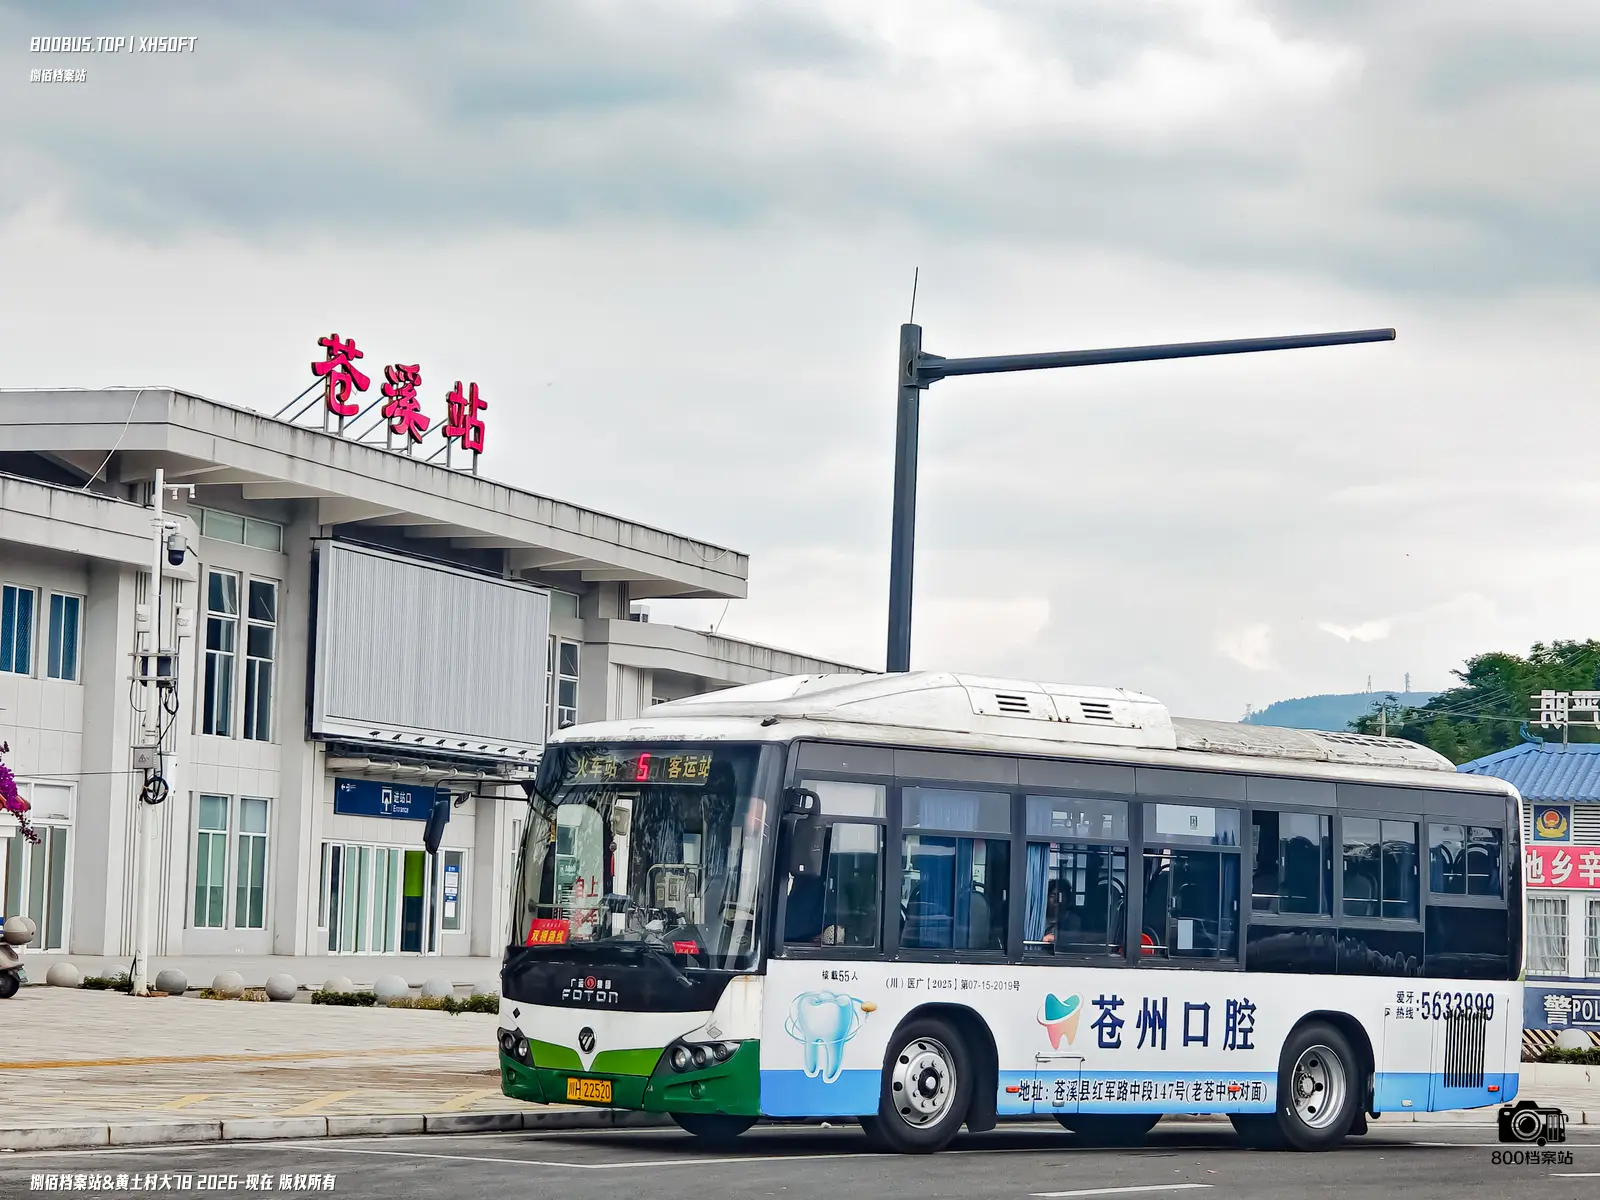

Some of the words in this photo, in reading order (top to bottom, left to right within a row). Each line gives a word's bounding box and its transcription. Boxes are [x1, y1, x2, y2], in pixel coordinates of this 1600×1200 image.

[311, 333, 488, 454] 苍溪站
[575, 755, 617, 779] 火车站
[635, 753, 651, 781] 5
[668, 755, 712, 779] 客运站
[561, 988, 619, 1004] FOTON
[1090, 995, 1257, 1051] 苍州口腔
